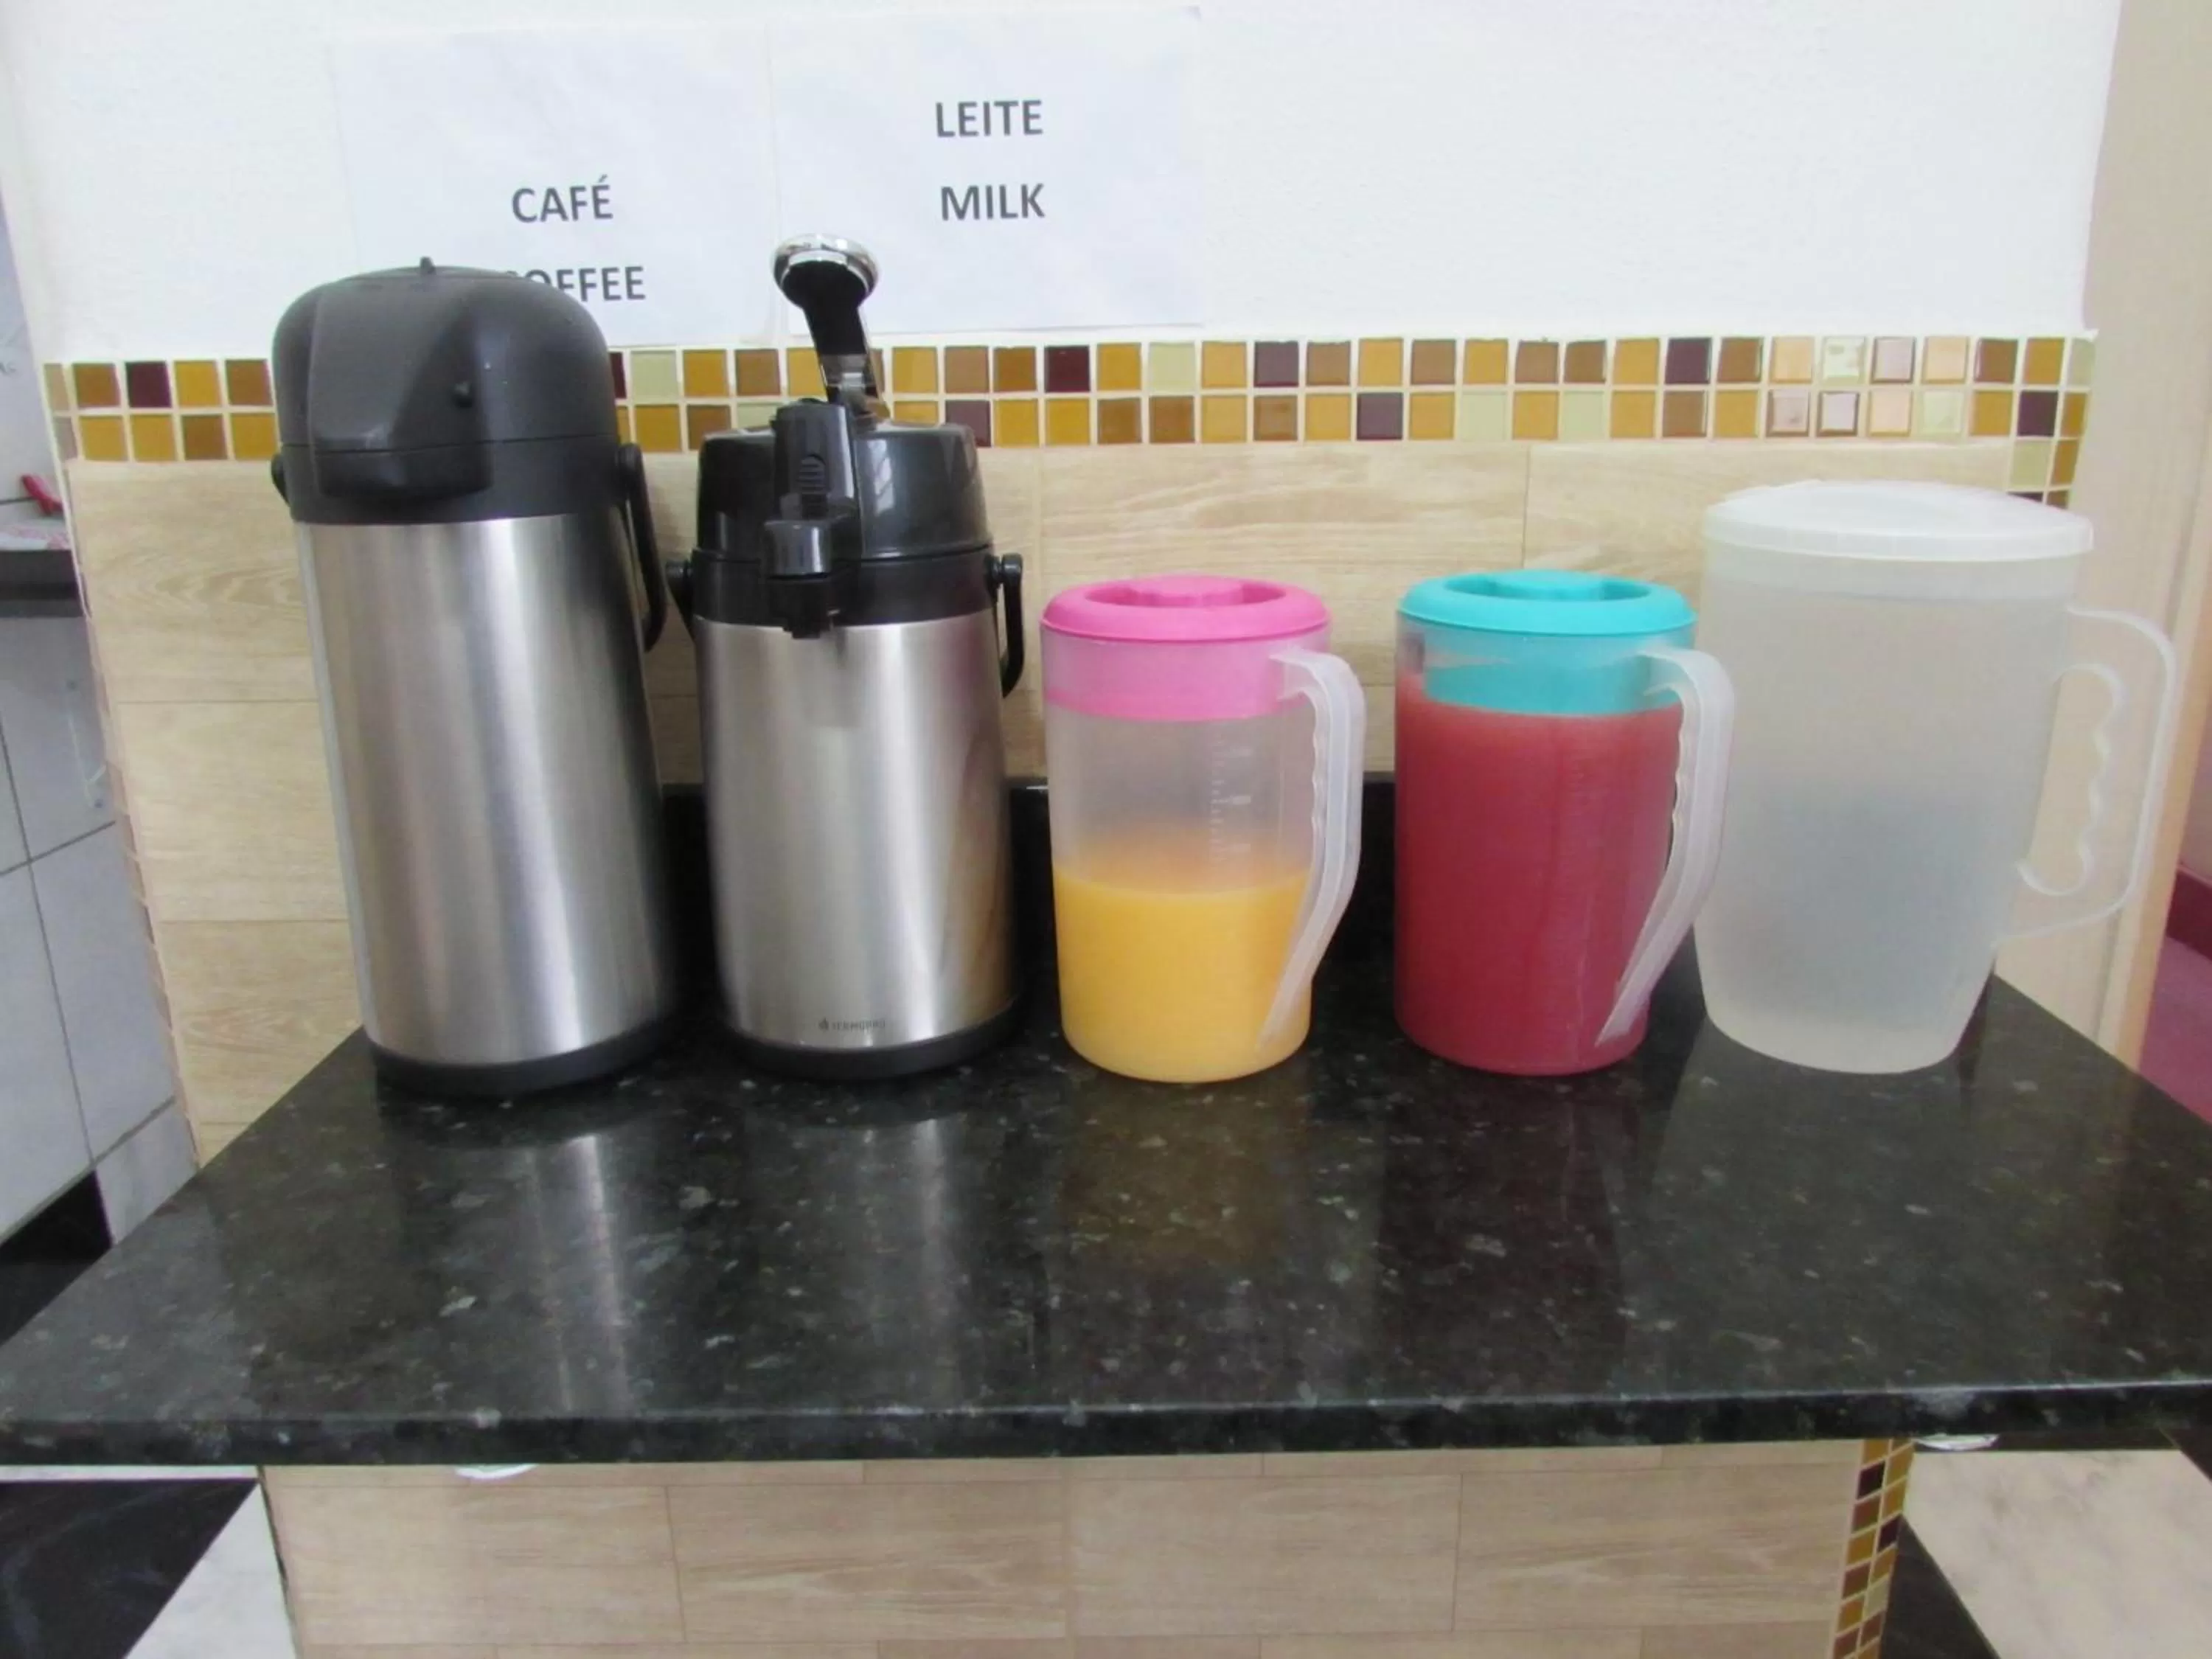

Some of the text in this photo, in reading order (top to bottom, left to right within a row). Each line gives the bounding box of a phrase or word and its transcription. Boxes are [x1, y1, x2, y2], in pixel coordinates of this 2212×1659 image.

[936, 100, 1043, 138] LEITE
[512, 175, 613, 223] CAFÉ
[941, 184, 1045, 221] MILK
